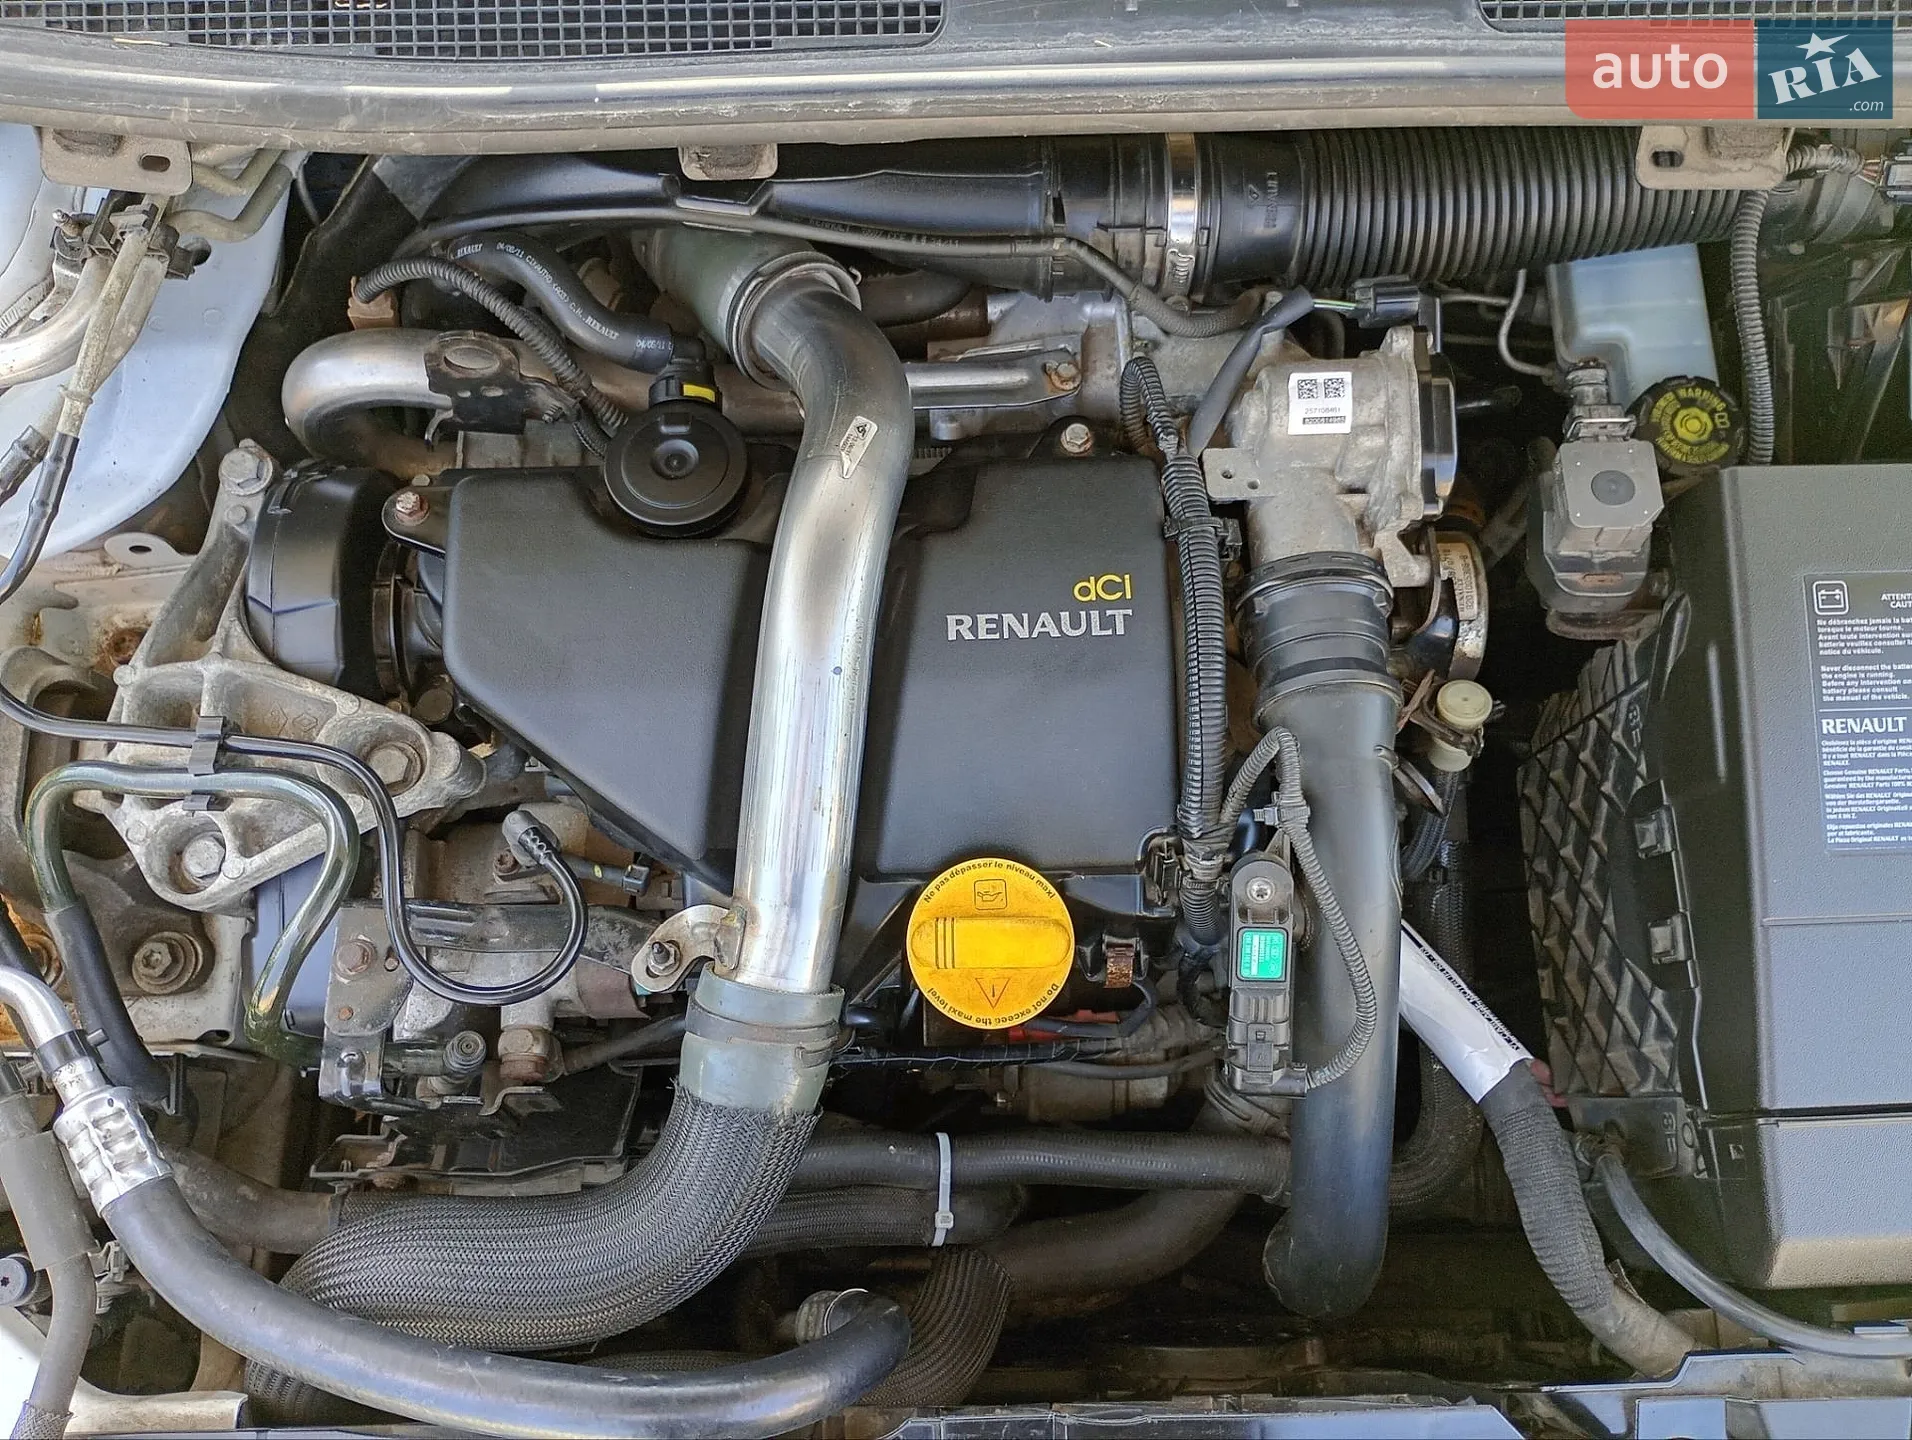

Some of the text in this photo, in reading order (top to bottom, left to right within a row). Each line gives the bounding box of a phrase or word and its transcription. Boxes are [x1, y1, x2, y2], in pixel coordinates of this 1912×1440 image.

[946, 609, 1133, 641] RENAULT
[1821, 716, 1907, 734] RENAULT
[923, 890, 936, 903] Ne
[935, 877, 949, 892] pas
[949, 861, 993, 880] dépasser
[1006, 863, 1036, 881] niveau
[1036, 879, 1057, 899] maxi
[928, 983, 1060, 1026] Do not exceed the maxi level
